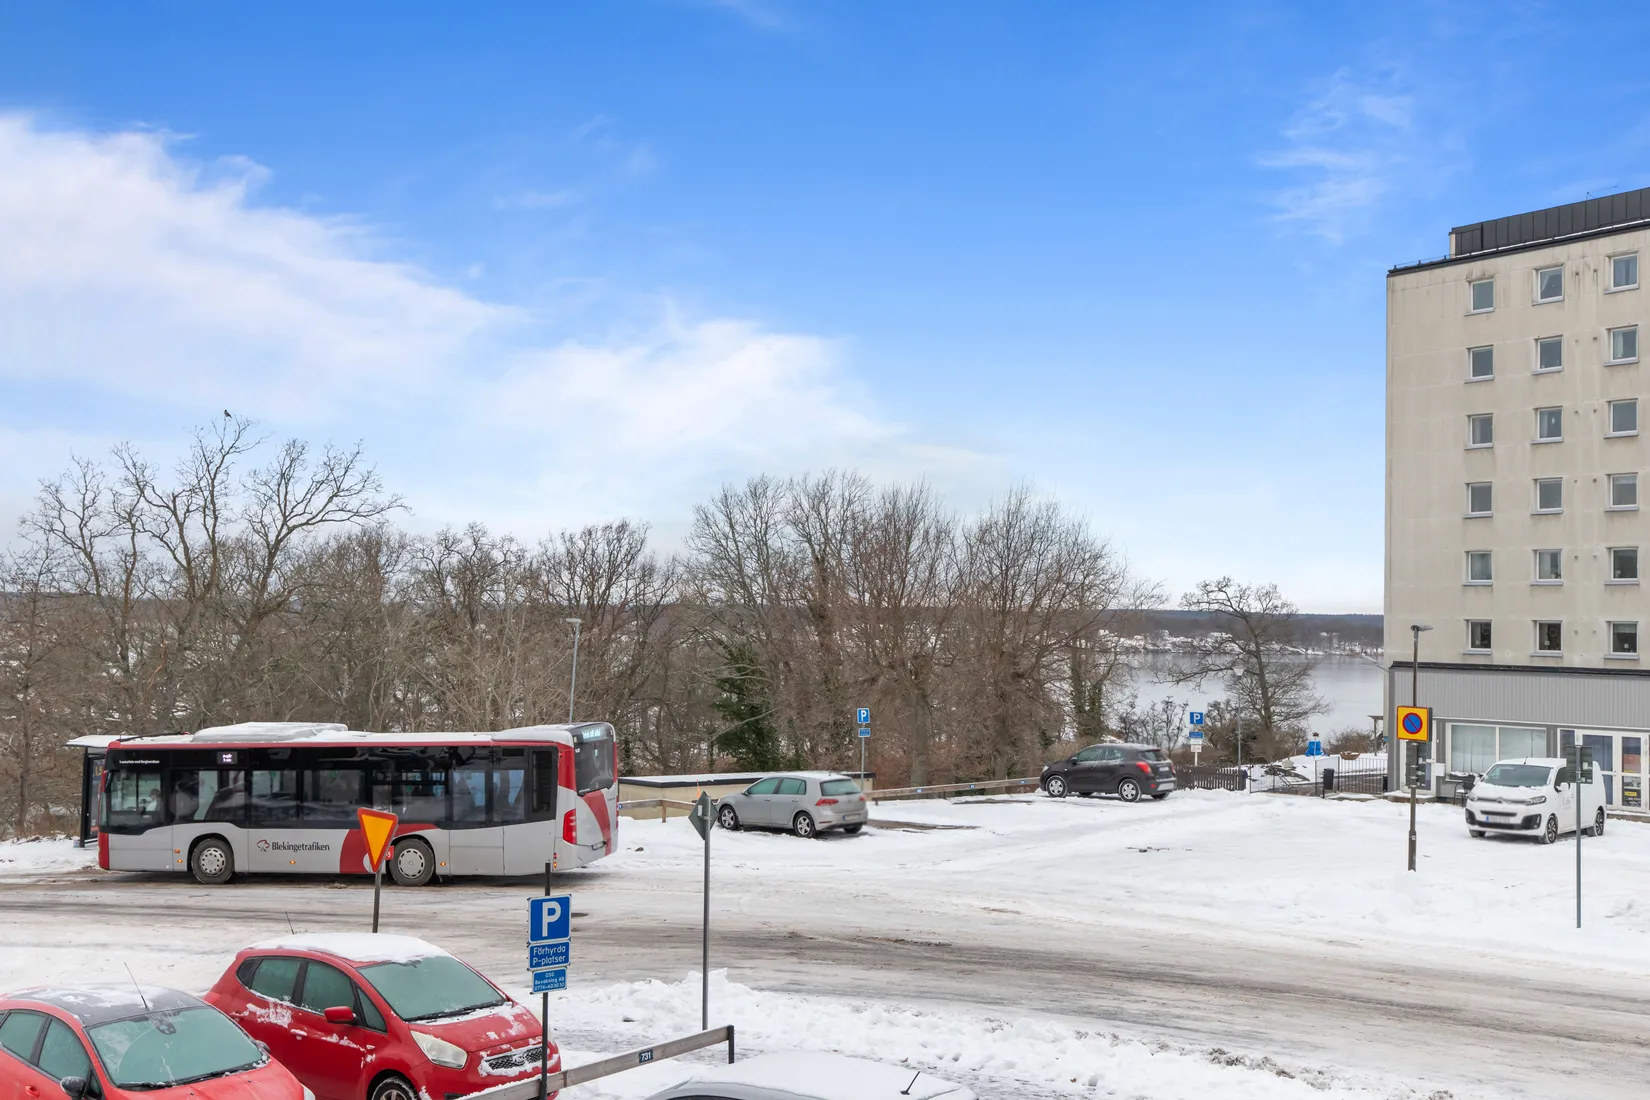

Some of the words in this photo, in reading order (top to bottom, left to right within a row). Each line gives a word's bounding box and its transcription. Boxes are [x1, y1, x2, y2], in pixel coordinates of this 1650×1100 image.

[861, 710, 867, 722] P
[1193, 713, 1201, 723] P
[271, 841, 330, 853] Blekingetrafiken
[542, 901, 561, 937] P
[533, 945, 566, 957] Förhyrda
[533, 955, 566, 967] P-platser
[641, 1051, 651, 1062] 731
